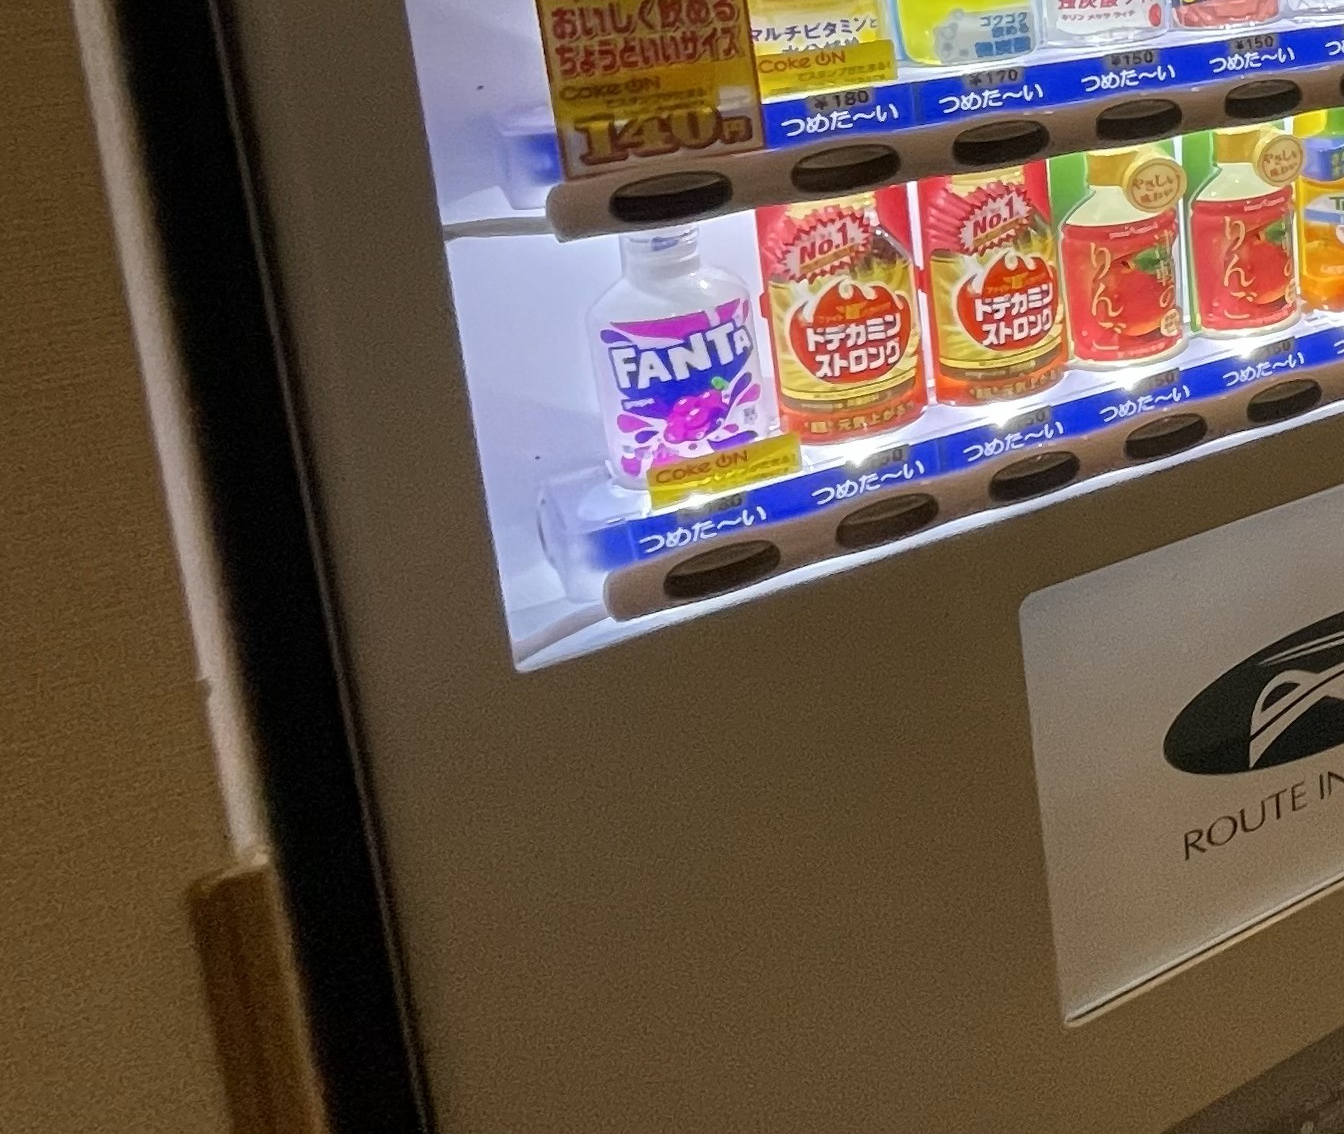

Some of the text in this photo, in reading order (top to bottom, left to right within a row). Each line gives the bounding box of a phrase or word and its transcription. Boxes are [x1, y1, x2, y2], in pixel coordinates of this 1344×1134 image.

[555, 27, 742, 79] ちょうどいいサイズ
[758, 50, 846, 74] Coke ON
[1208, 46, 1296, 74] つめた〜い
[938, 83, 1044, 114] つめた〜い
[971, 199, 1017, 236] No.1
[797, 228, 854, 264] No.1
[1222, 215, 1257, 320] りんご
[973, 282, 1054, 323] ドデカミン
[1089, 241, 1128, 352] りんご
[805, 312, 901, 352] ドデカミン
[981, 306, 1053, 347] ストロング
[608, 320, 755, 396] FANTA
[814, 340, 901, 379] ストロング
[1222, 351, 1305, 388] つめた〜い
[963, 420, 1065, 463] つめた〜い
[655, 462, 710, 486] Coke
[1182, 781, 1307, 862] ROUTE
